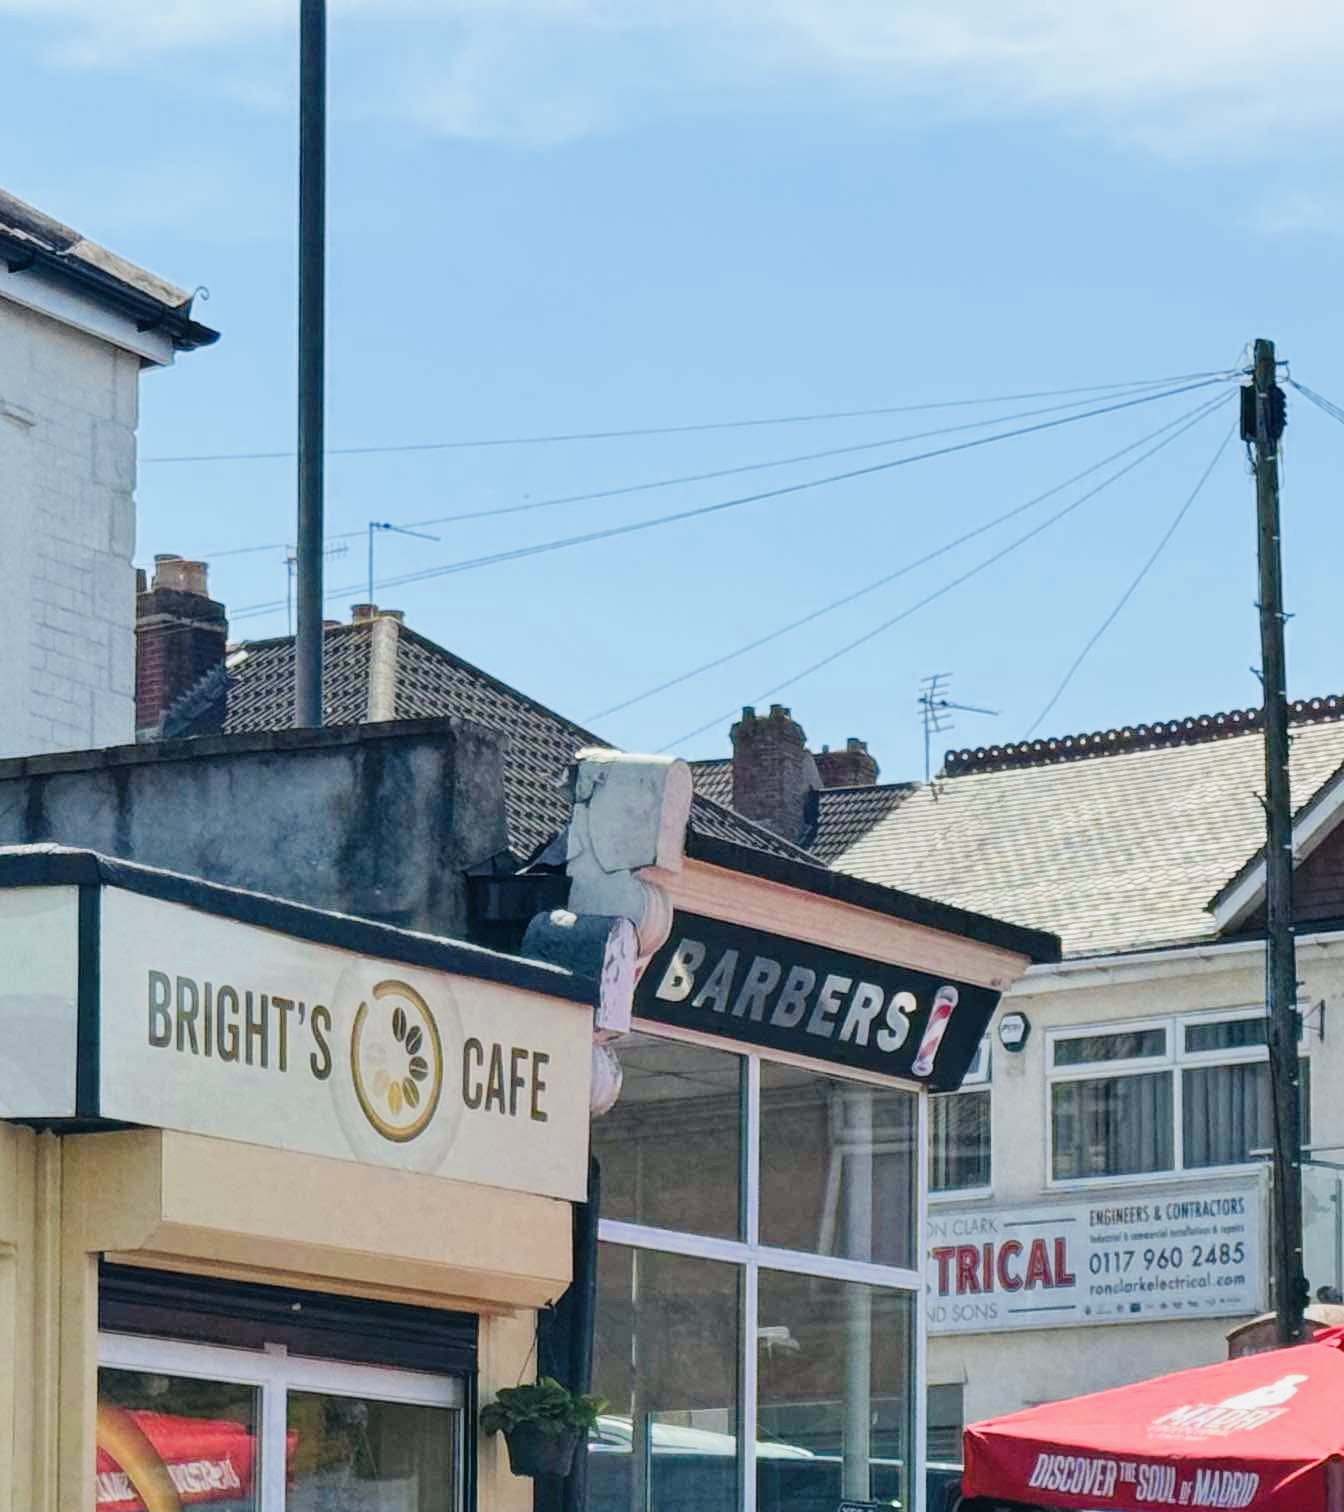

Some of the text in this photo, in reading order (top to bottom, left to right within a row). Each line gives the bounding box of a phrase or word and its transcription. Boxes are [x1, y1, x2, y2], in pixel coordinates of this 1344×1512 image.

[656, 937, 917, 1053] BARBERS
[147, 969, 550, 1123] BRIGHT'S CAFE
[951, 1216, 999, 1236] CLARK
[1089, 1197, 1245, 1228] ENGINEERS & CONTRACTORS
[927, 1236, 1076, 1297] TRICAL
[1089, 1241, 1245, 1276] 0117 960 2485
[1089, 1271, 1246, 1297] ronclarkelectrical.com
[951, 1302, 999, 1321] SONS
[1028, 1453, 1118, 1498] DISCOVER
[1119, 1461, 1137, 1483] THE
[1136, 1463, 1176, 1504] SOUL
[1192, 1468, 1260, 1509] MADRID
